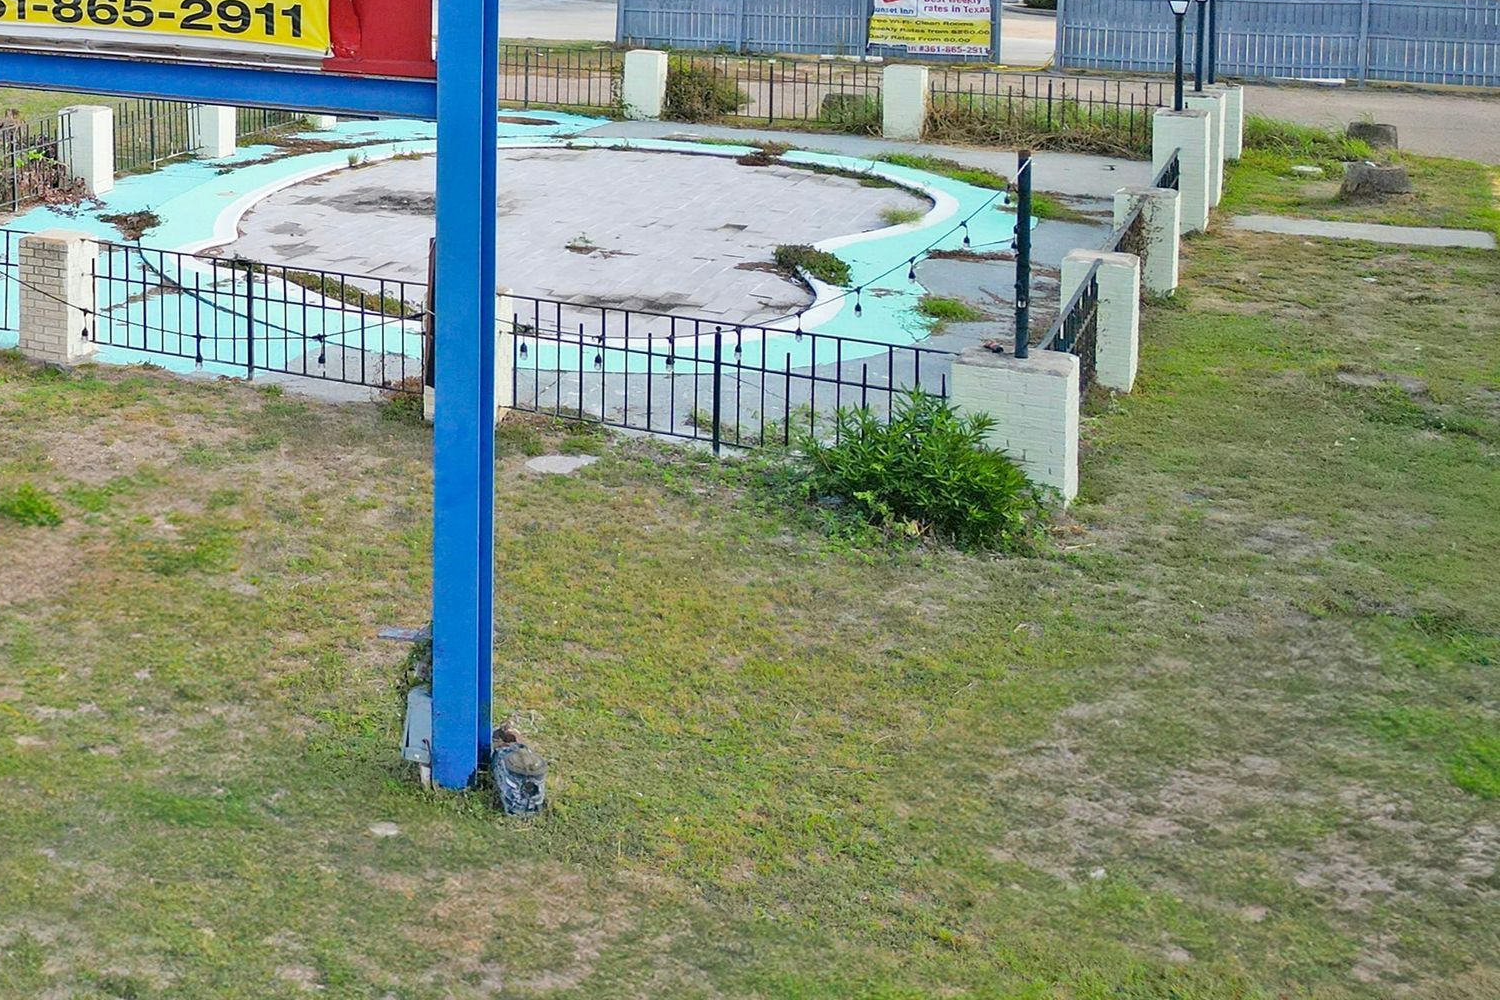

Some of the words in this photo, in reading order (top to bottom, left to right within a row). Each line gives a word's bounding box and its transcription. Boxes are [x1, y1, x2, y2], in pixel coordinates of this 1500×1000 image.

[900, 7, 915, 15] Inn
[924, 5, 949, 13] rates
[951, 5, 961, 13] in
[963, 5, 990, 14] Texas
